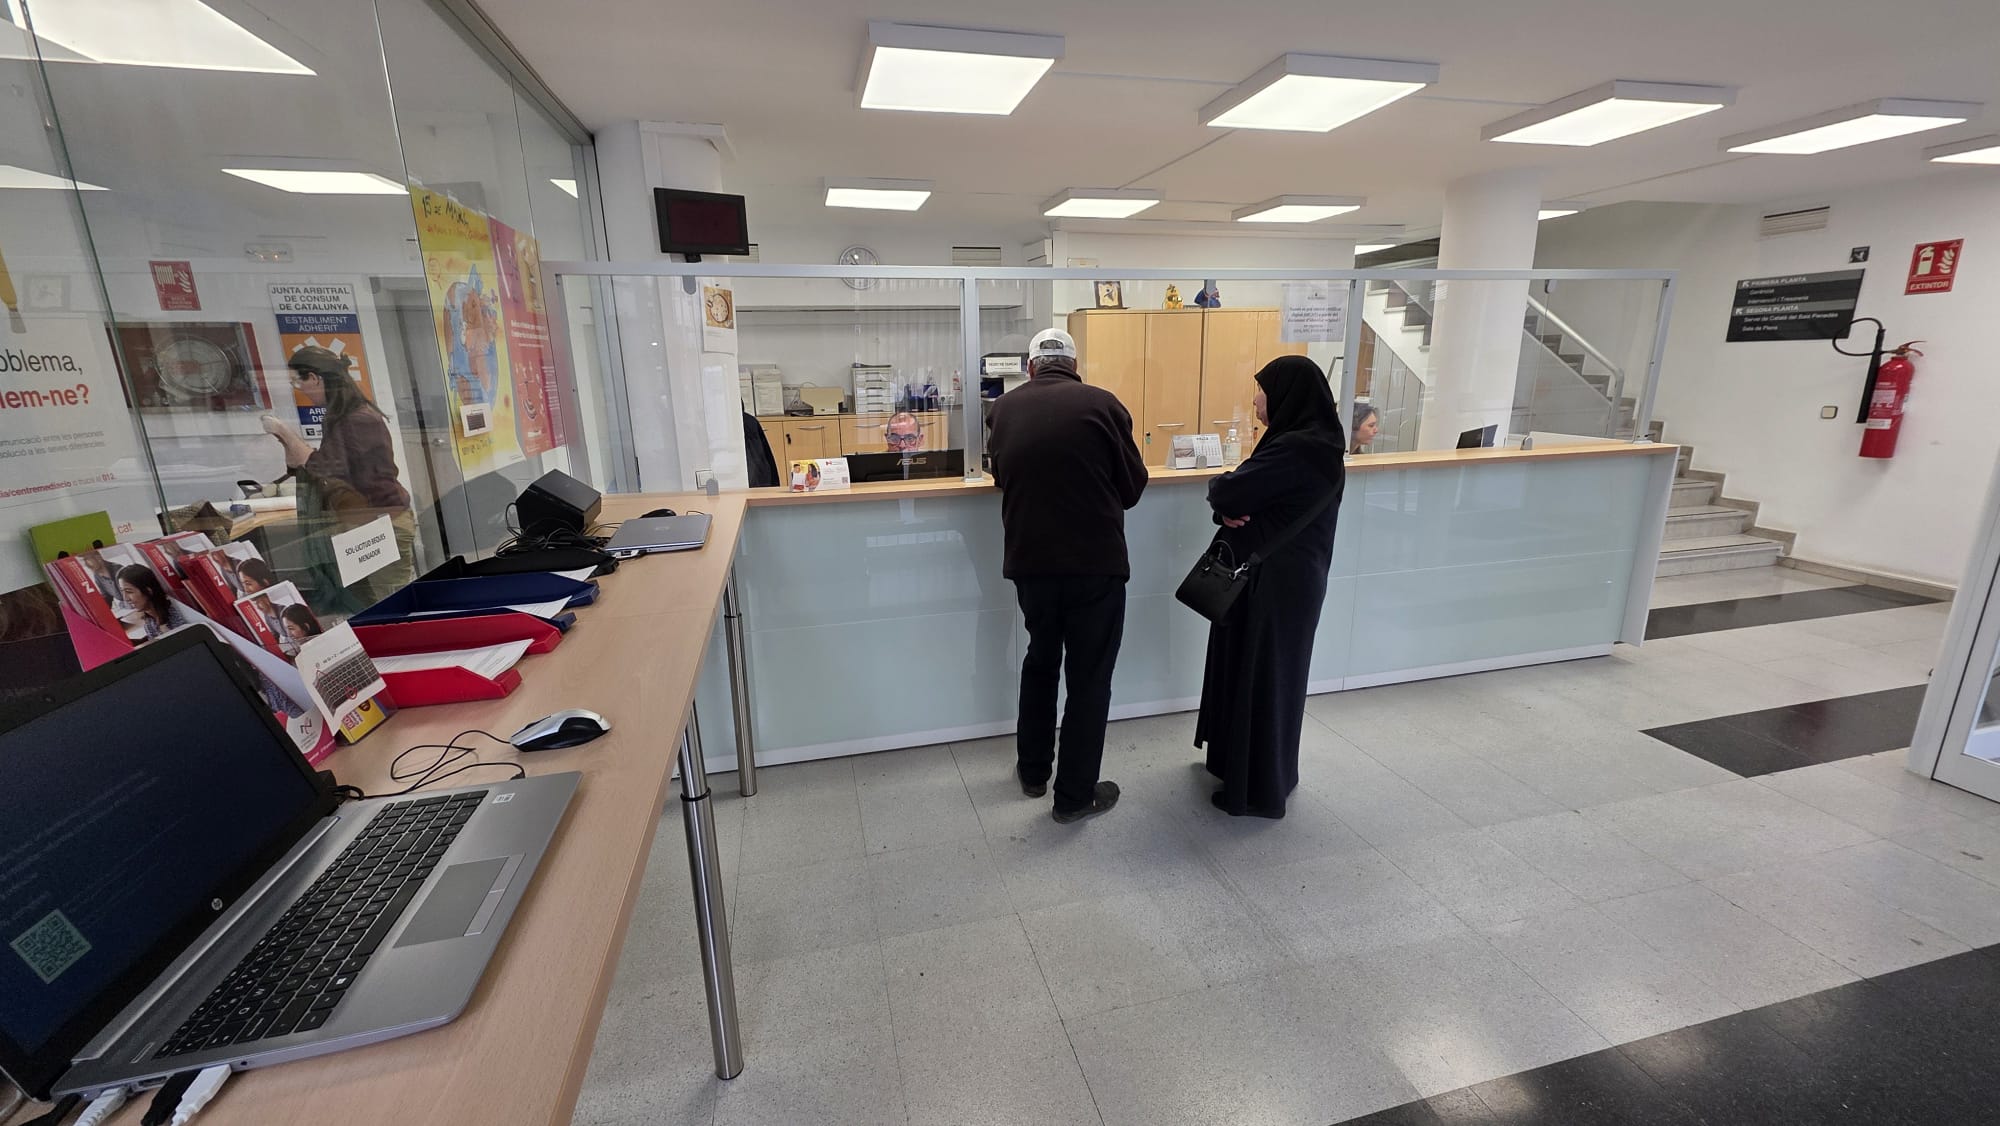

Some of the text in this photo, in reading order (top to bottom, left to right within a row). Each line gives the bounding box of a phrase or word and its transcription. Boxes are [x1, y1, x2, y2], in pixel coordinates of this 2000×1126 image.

[1780, 277, 1807, 285] PLANTA
[1909, 281, 1949, 290] EXTINTOR
[271, 287, 351, 295] JUNTA ARBITRAL
[284, 295, 341, 303] DE CONSUM
[279, 303, 350, 311] DE CATALUNYA
[1746, 304, 1800, 314] SEGONA PLANTA
[285, 316, 348, 325] ESTABLIMENT
[299, 324, 339, 332] ADHERIT
[0, 349, 83, 375] oblema,
[896, 457, 927, 466] ASUS
[358, 547, 381, 564] MENJADOR
